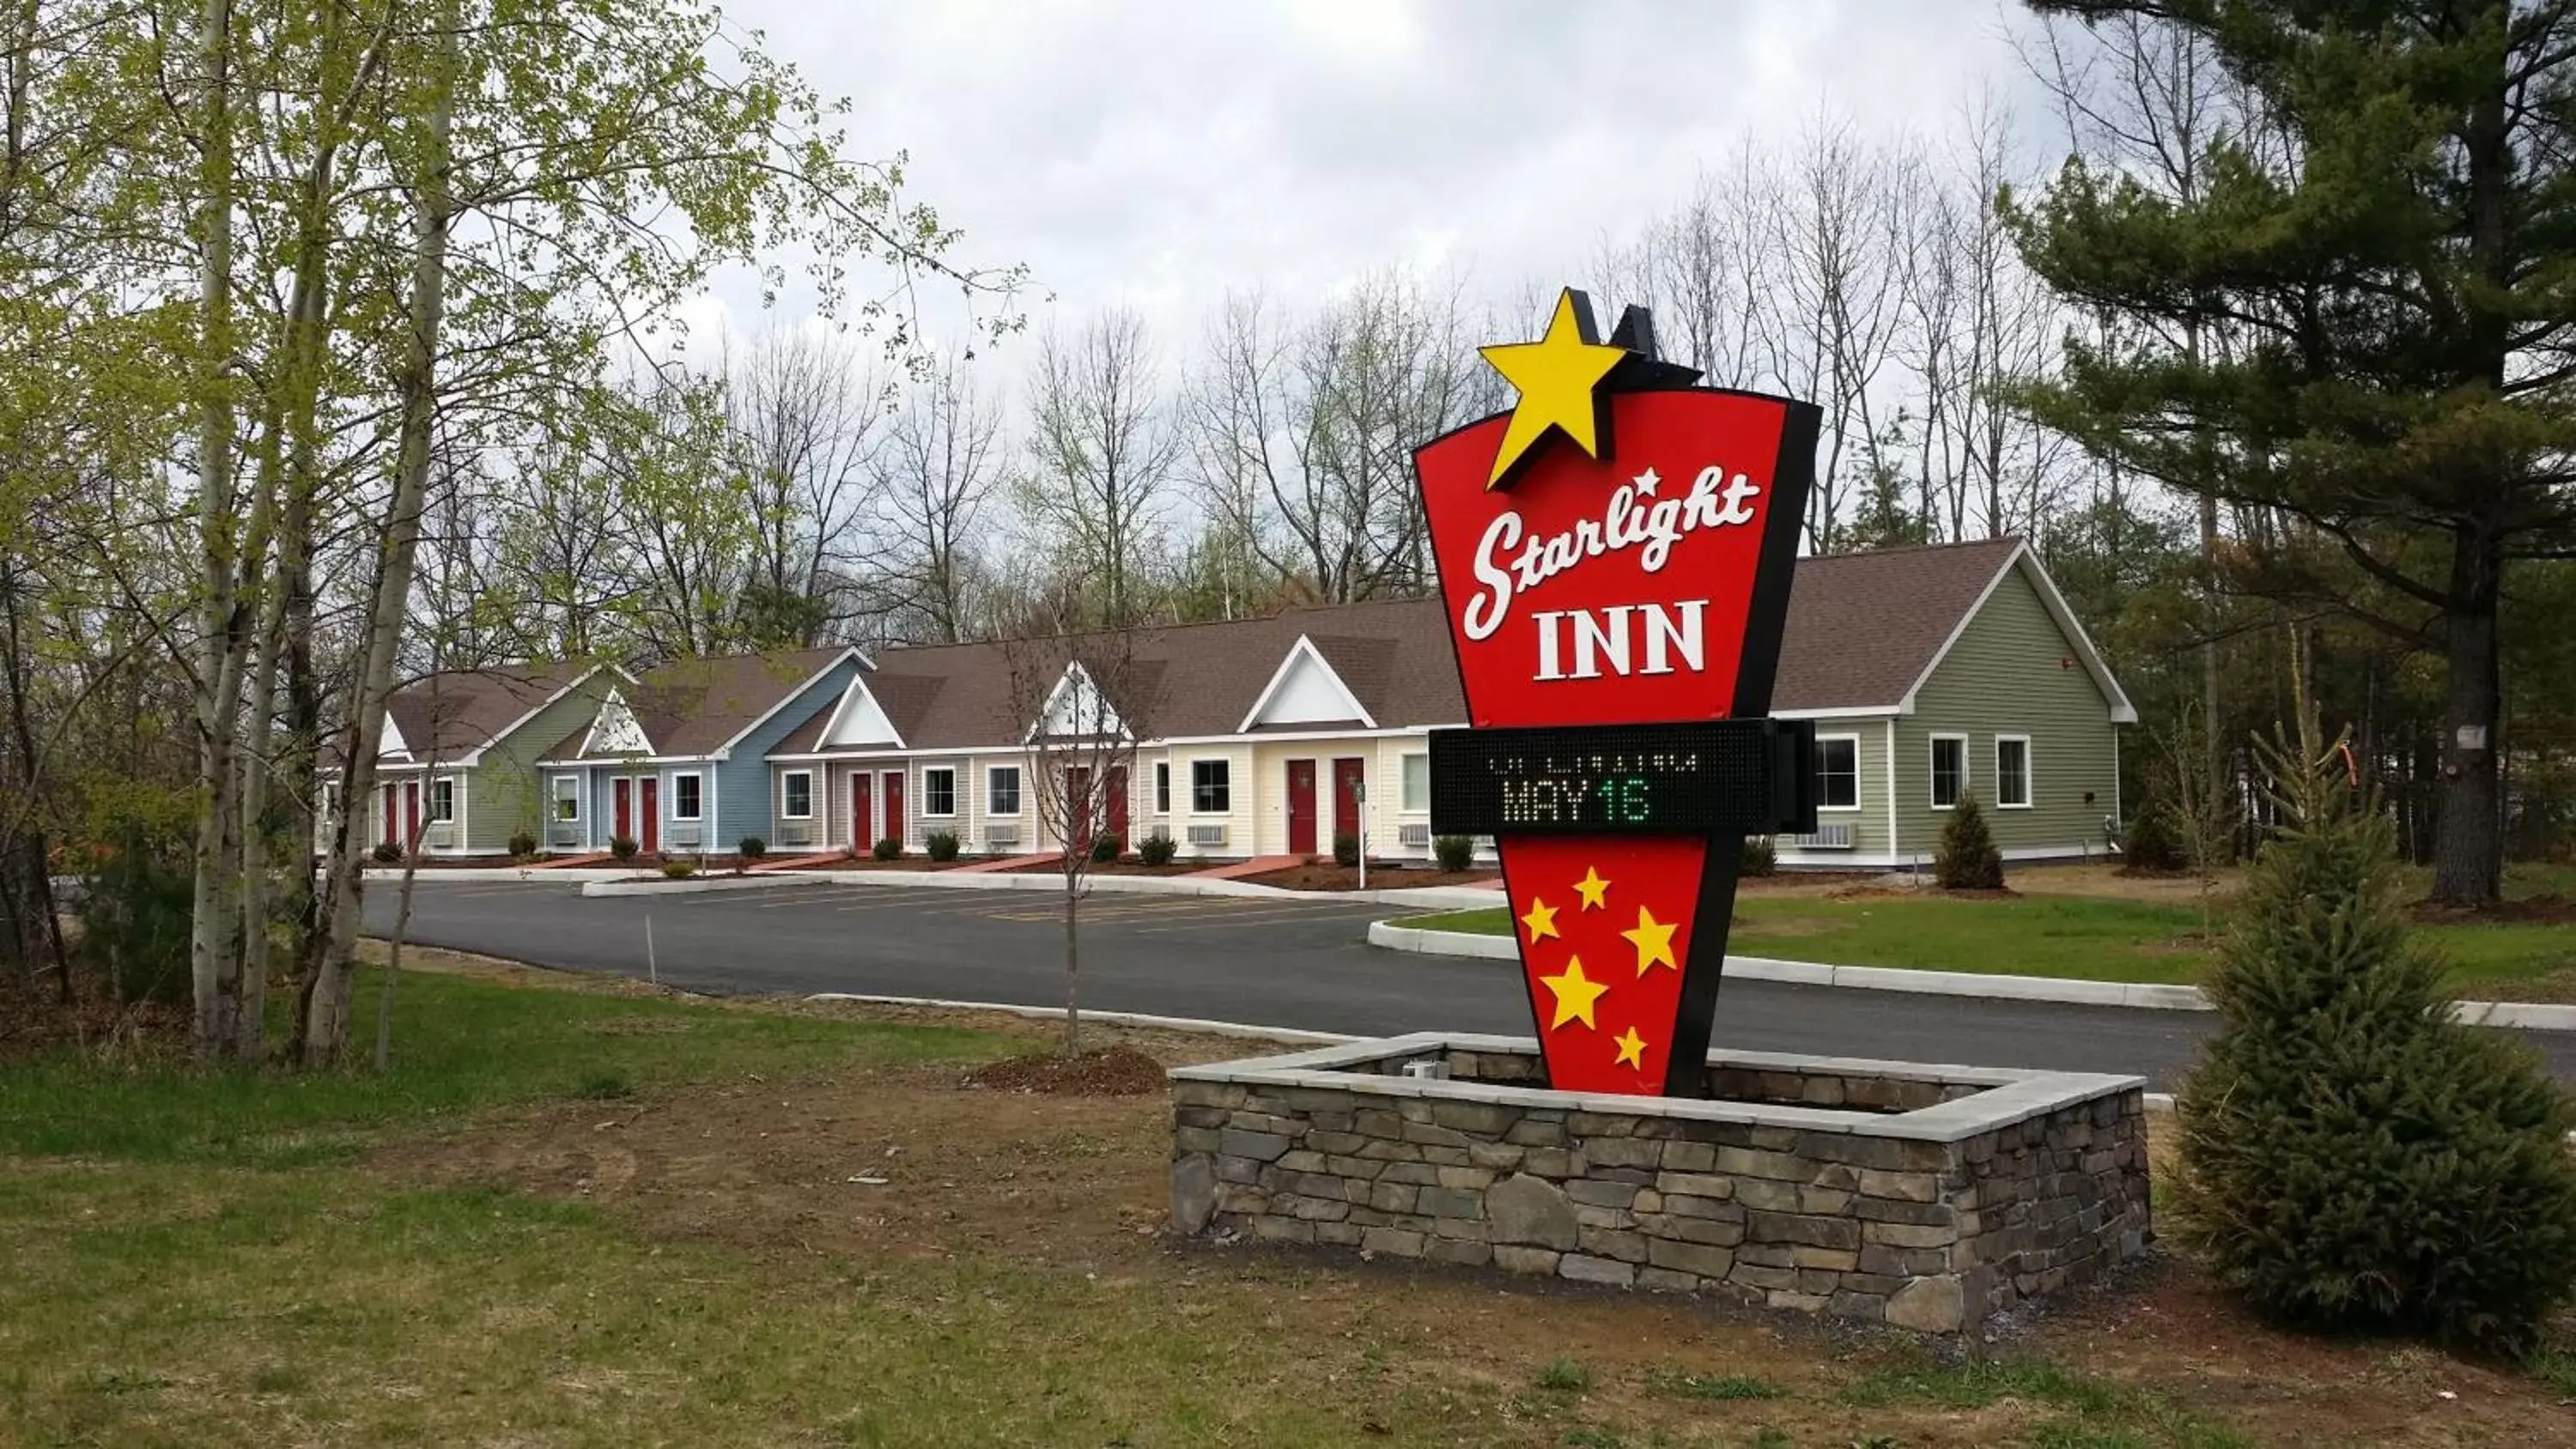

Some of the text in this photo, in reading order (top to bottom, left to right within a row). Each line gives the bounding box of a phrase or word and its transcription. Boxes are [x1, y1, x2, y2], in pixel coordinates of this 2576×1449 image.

[1463, 465, 1760, 640] Starlight
[1531, 599, 1709, 681] INN
[1504, 779, 1650, 822] MAY 16
